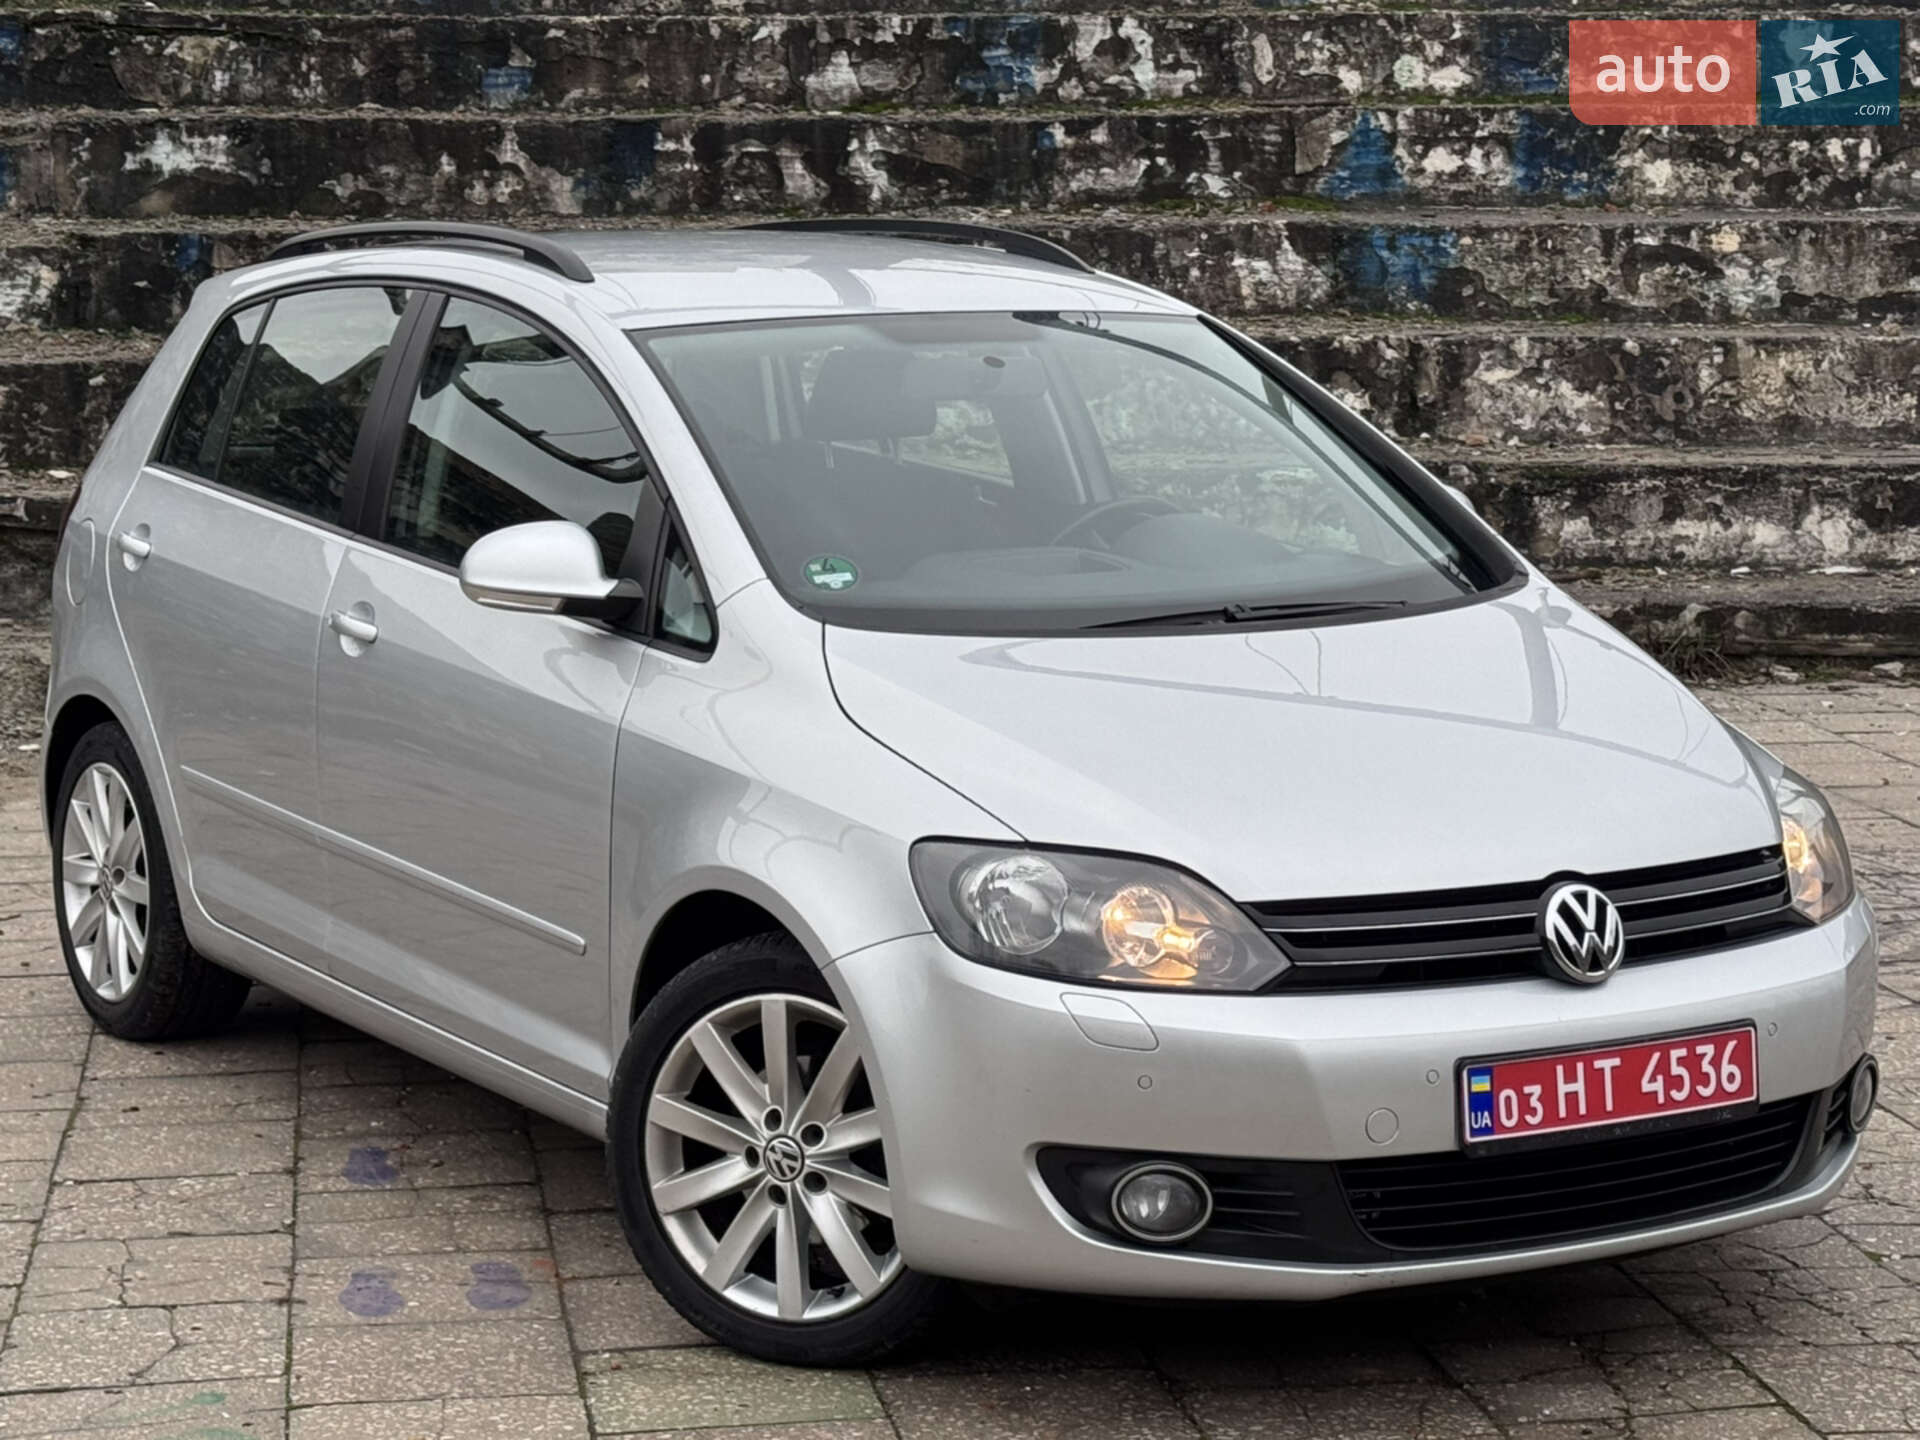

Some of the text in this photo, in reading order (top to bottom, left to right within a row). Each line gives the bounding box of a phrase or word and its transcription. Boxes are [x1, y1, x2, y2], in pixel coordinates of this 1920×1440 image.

[1498, 1039, 1742, 1128] 03 HT 4536
[1470, 1110, 1492, 1129] UA
